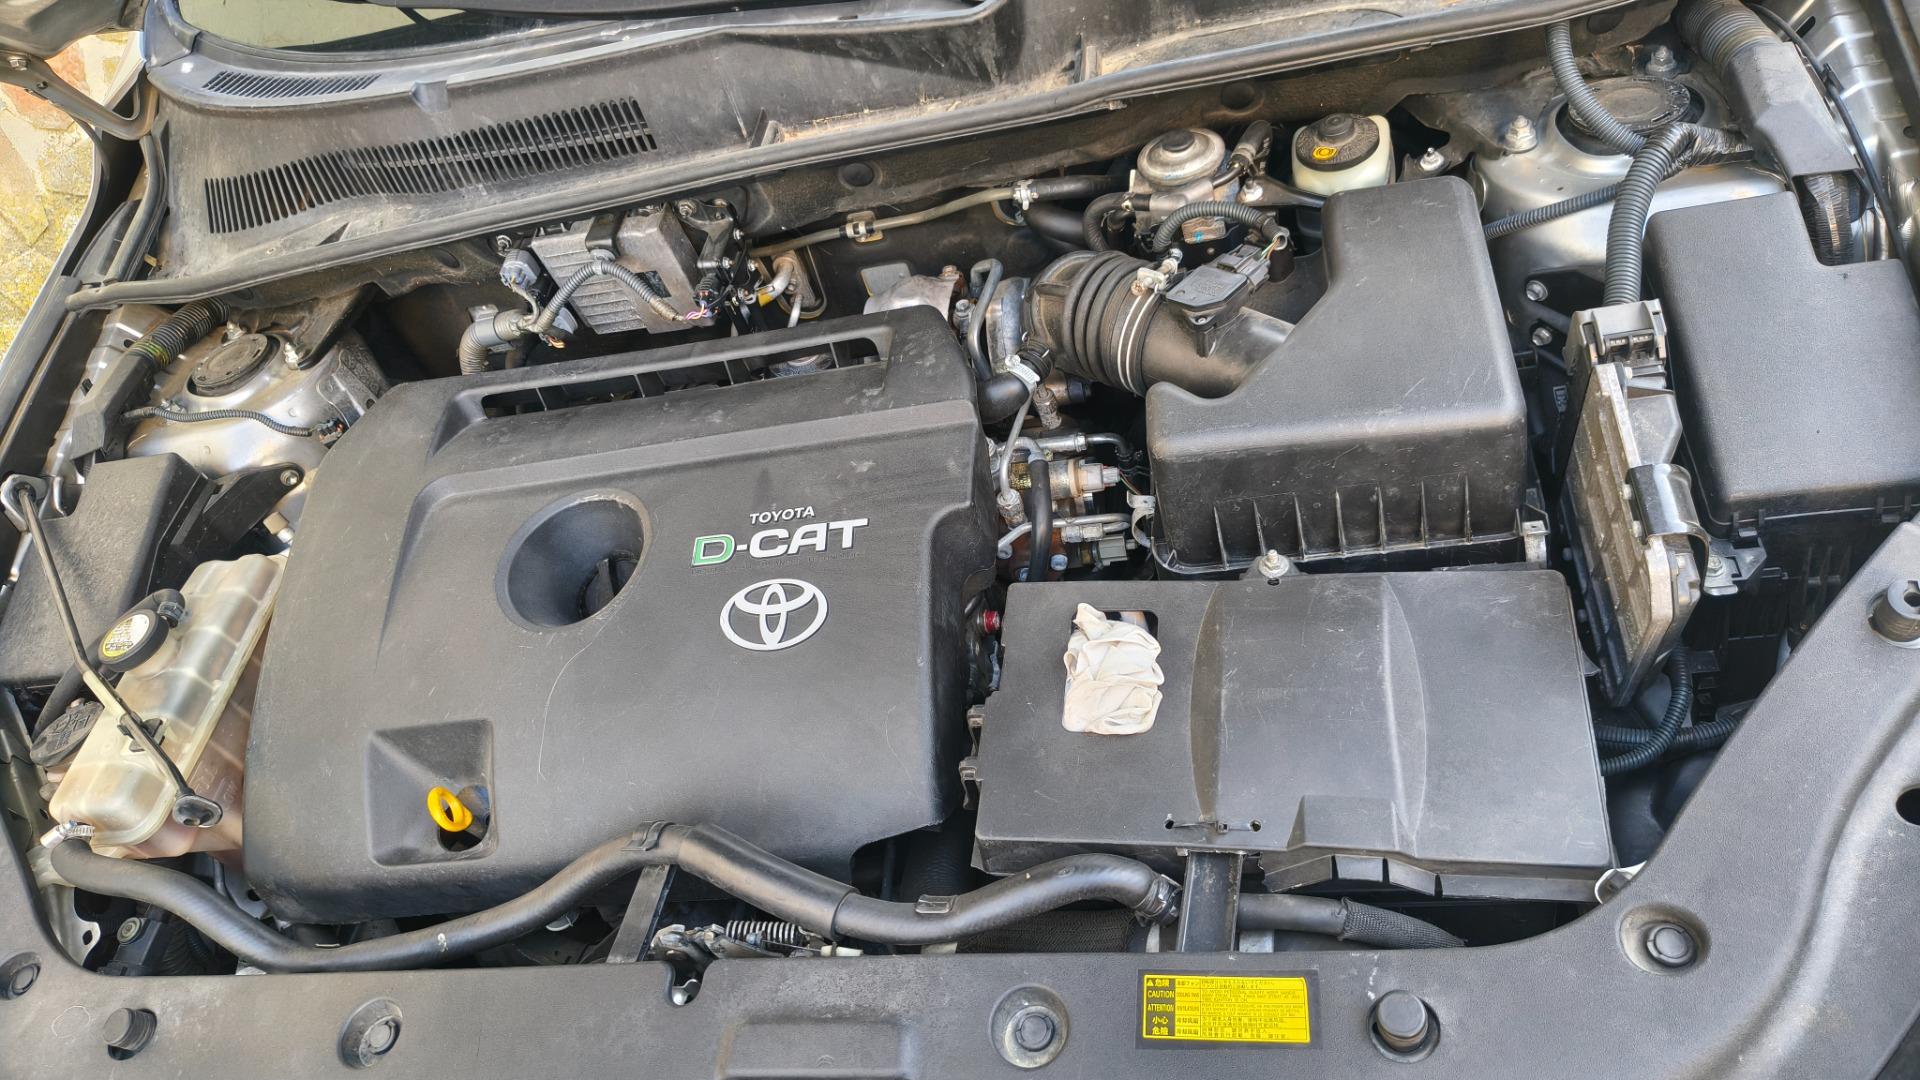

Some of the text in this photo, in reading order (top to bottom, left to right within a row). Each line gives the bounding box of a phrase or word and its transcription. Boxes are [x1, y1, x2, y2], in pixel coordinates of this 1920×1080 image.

[750, 506, 815, 525] TOYOTA
[691, 517, 869, 567] D-CAT
[1147, 990, 1174, 999] CAUTION
[1147, 1003, 1174, 1012] ATTENTION
[1152, 1015, 1168, 1025] 小心
